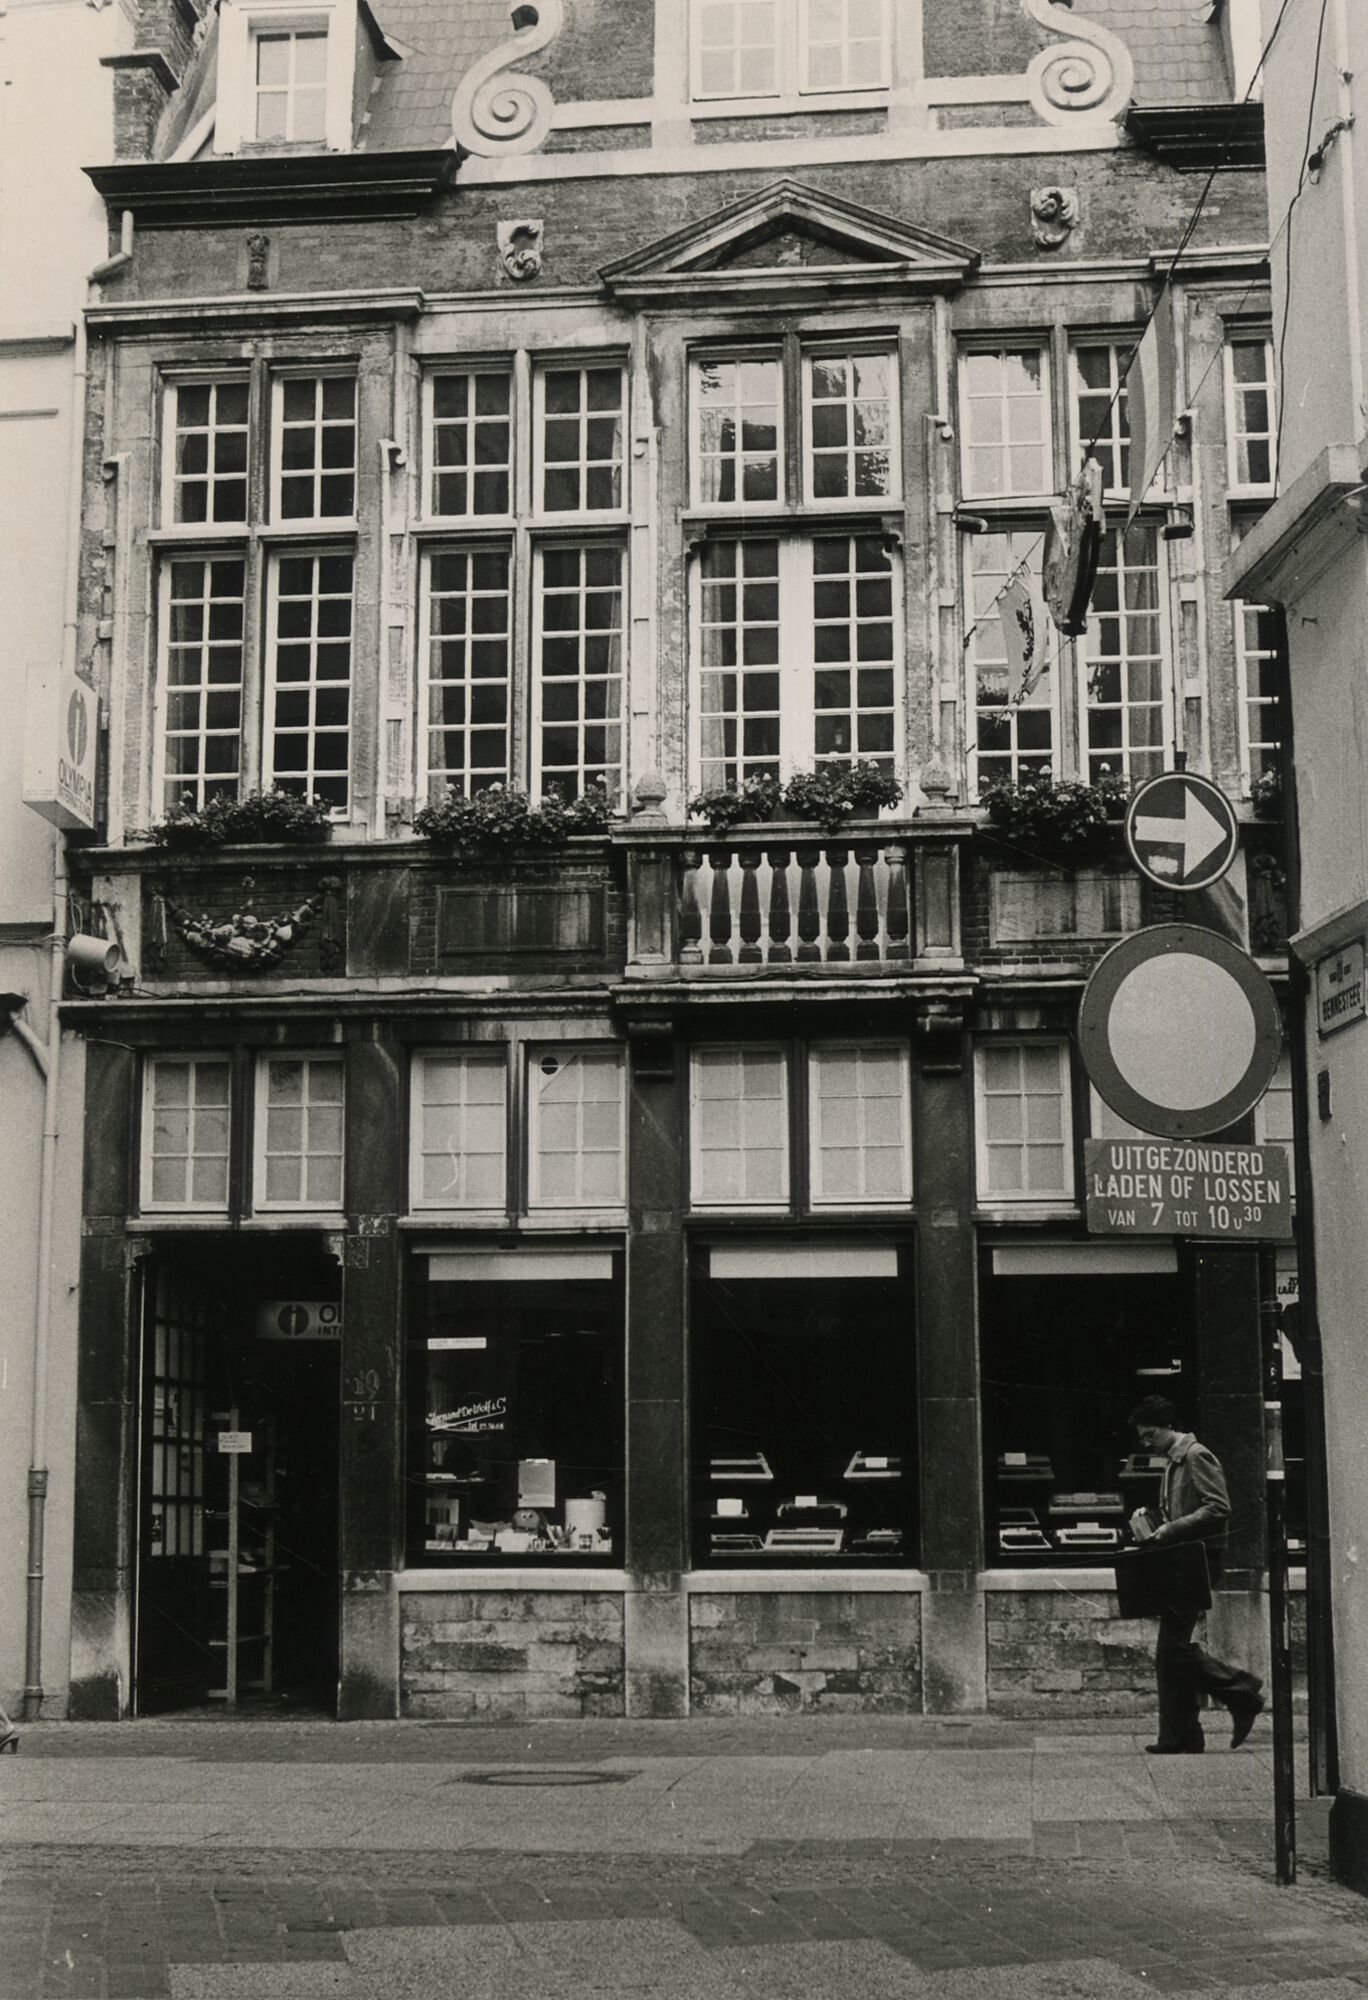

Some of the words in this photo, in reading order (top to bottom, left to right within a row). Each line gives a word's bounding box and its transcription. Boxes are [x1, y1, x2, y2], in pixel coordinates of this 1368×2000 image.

[58, 757, 93, 807] OLYMPIA
[1111, 1146, 1263, 1175] UITGEZONDERD
[1094, 1174, 1163, 1199] LADEN
[1170, 1175, 1194, 1199] OF
[1204, 1177, 1281, 1204] LOSSEN
[1108, 1209, 1136, 1226] VAN
[1151, 1202, 1165, 1227] 7
[1174, 1210, 1198, 1227] TOT
